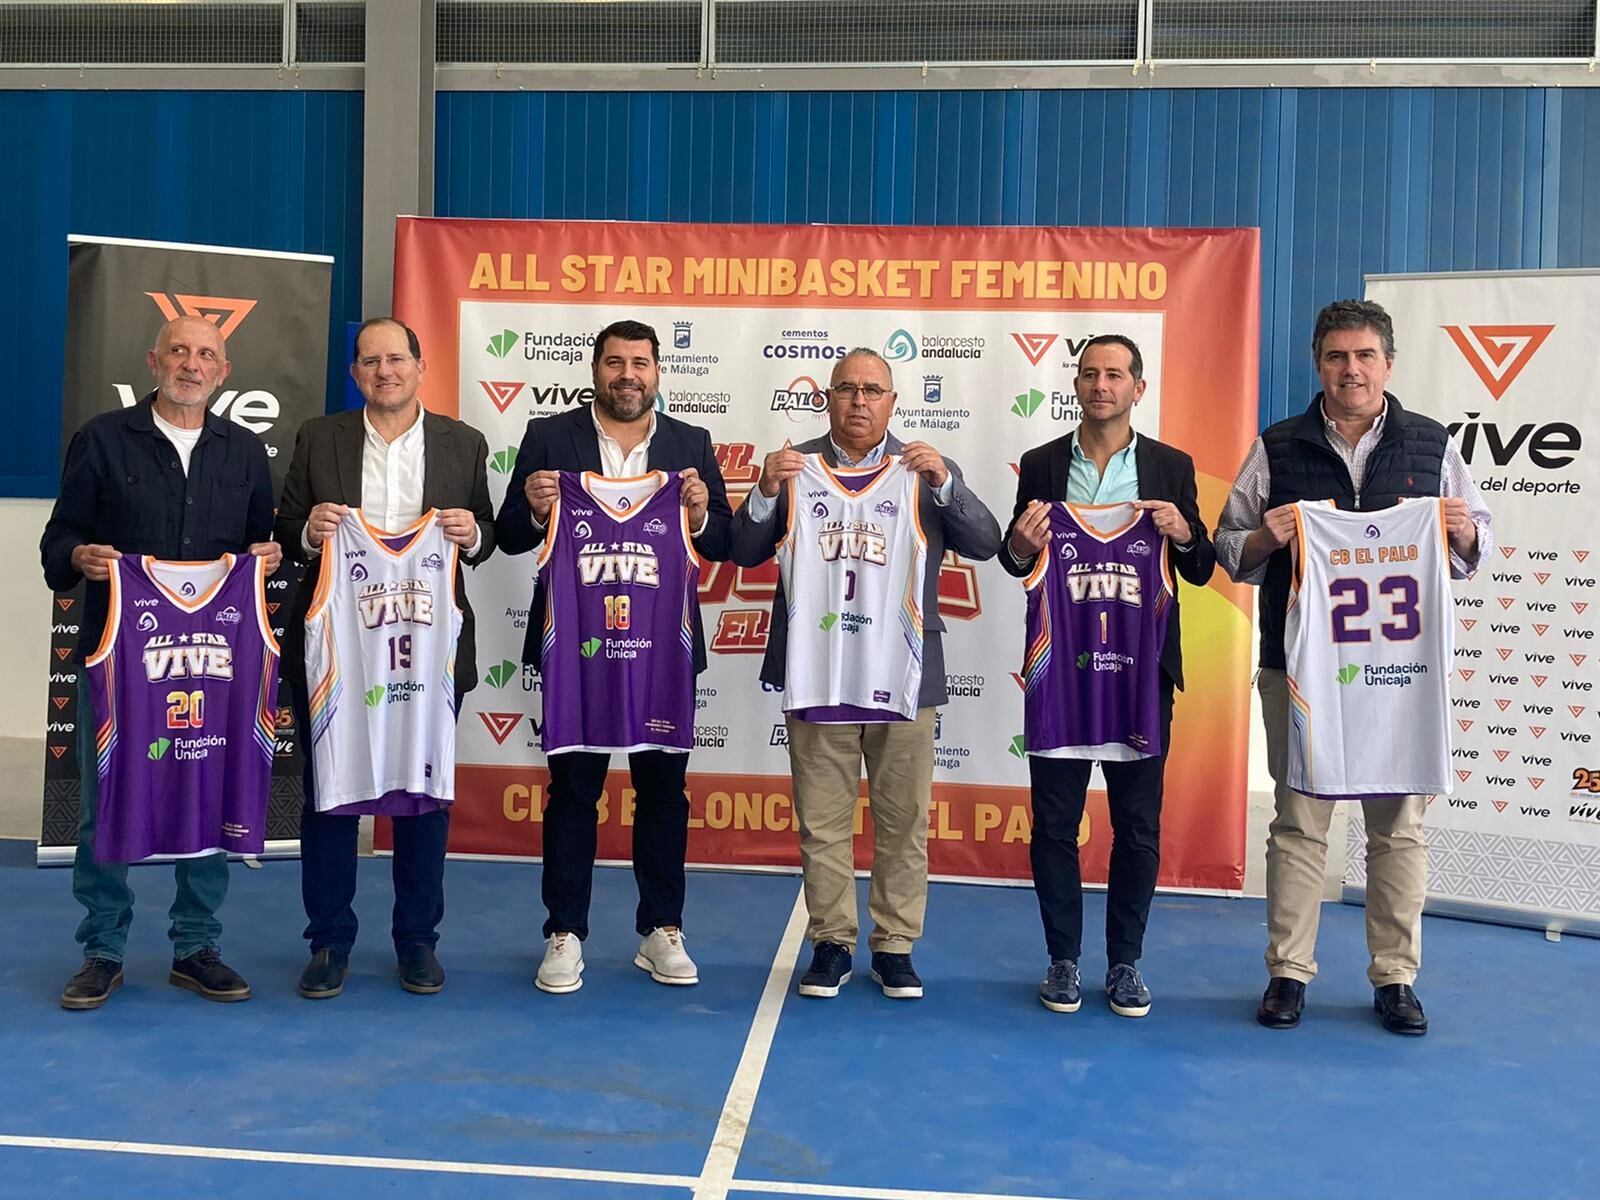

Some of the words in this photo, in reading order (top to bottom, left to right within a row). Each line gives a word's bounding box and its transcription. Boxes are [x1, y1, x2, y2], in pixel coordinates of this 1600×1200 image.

[469, 252, 550, 291] ALL
[561, 255, 673, 294] STAR
[683, 257, 940, 298] MINIBASKET
[951, 260, 1168, 300] FEMENINO
[524, 332, 597, 347] Fundació
[782, 329, 829, 338] cementos
[922, 335, 985, 348] baloncesto
[524, 347, 583, 365] Unicaja
[763, 344, 847, 359] cosmos
[659, 353, 719, 364] untamiento
[670, 364, 709, 377] Málaga
[669, 389, 731, 402] baloncesto
[770, 390, 830, 413] PALO
[894, 406, 970, 418] Ayuntamiento
[903, 419, 917, 428] de
[920, 418, 960, 431] Málaga
[1480, 477, 1508, 492] del
[1512, 477, 1581, 496] deporte
[808, 490, 829, 498] vive
[571, 508, 594, 516] vive
[345, 549, 367, 559] vive
[580, 542, 607, 555] ALL
[622, 541, 656, 556] STAR
[818, 533, 886, 567] VIVE
[1330, 549, 1350, 565] CB
[1355, 547, 1374, 564] EL
[1378, 544, 1419, 563] PALO
[1528, 550, 1558, 561] vive
[577, 554, 660, 589] VIVE
[1067, 562, 1092, 575] ALL
[1105, 562, 1138, 576] STAR
[1492, 572, 1522, 583] vive
[1565, 576, 1596, 588] vive
[358, 582, 387, 599] ALL
[1066, 573, 1142, 608] VIVE
[134, 598, 159, 607] vive
[1454, 596, 1484, 607] vive
[1526, 601, 1556, 612] vive
[358, 593, 433, 629] VIVE
[604, 595, 630, 630] 18
[1328, 574, 1421, 645] 23
[1099, 611, 1108, 644] 1
[1490, 623, 1520, 634] vive
[1563, 628, 1594, 639] vive
[144, 634, 174, 650] ALL
[191, 632, 229, 647] STAR
[388, 634, 412, 671] 19
[1524, 652, 1555, 664] vive
[142, 647, 233, 683] VIVE
[1364, 662, 1428, 675] Fundación
[1364, 675, 1411, 688] Unicaja
[1489, 674, 1519, 685] vive
[1561, 680, 1592, 691] vive
[166, 690, 205, 729] 20
[1451, 697, 1481, 709] vive
[1523, 704, 1553, 715] vive
[1487, 724, 1517, 736] vive
[1560, 731, 1591, 743] vive
[1521, 754, 1552, 766] vive
[1485, 775, 1516, 787] vive
[1448, 798, 1478, 810] vive
[1520, 806, 1551, 818] vive
